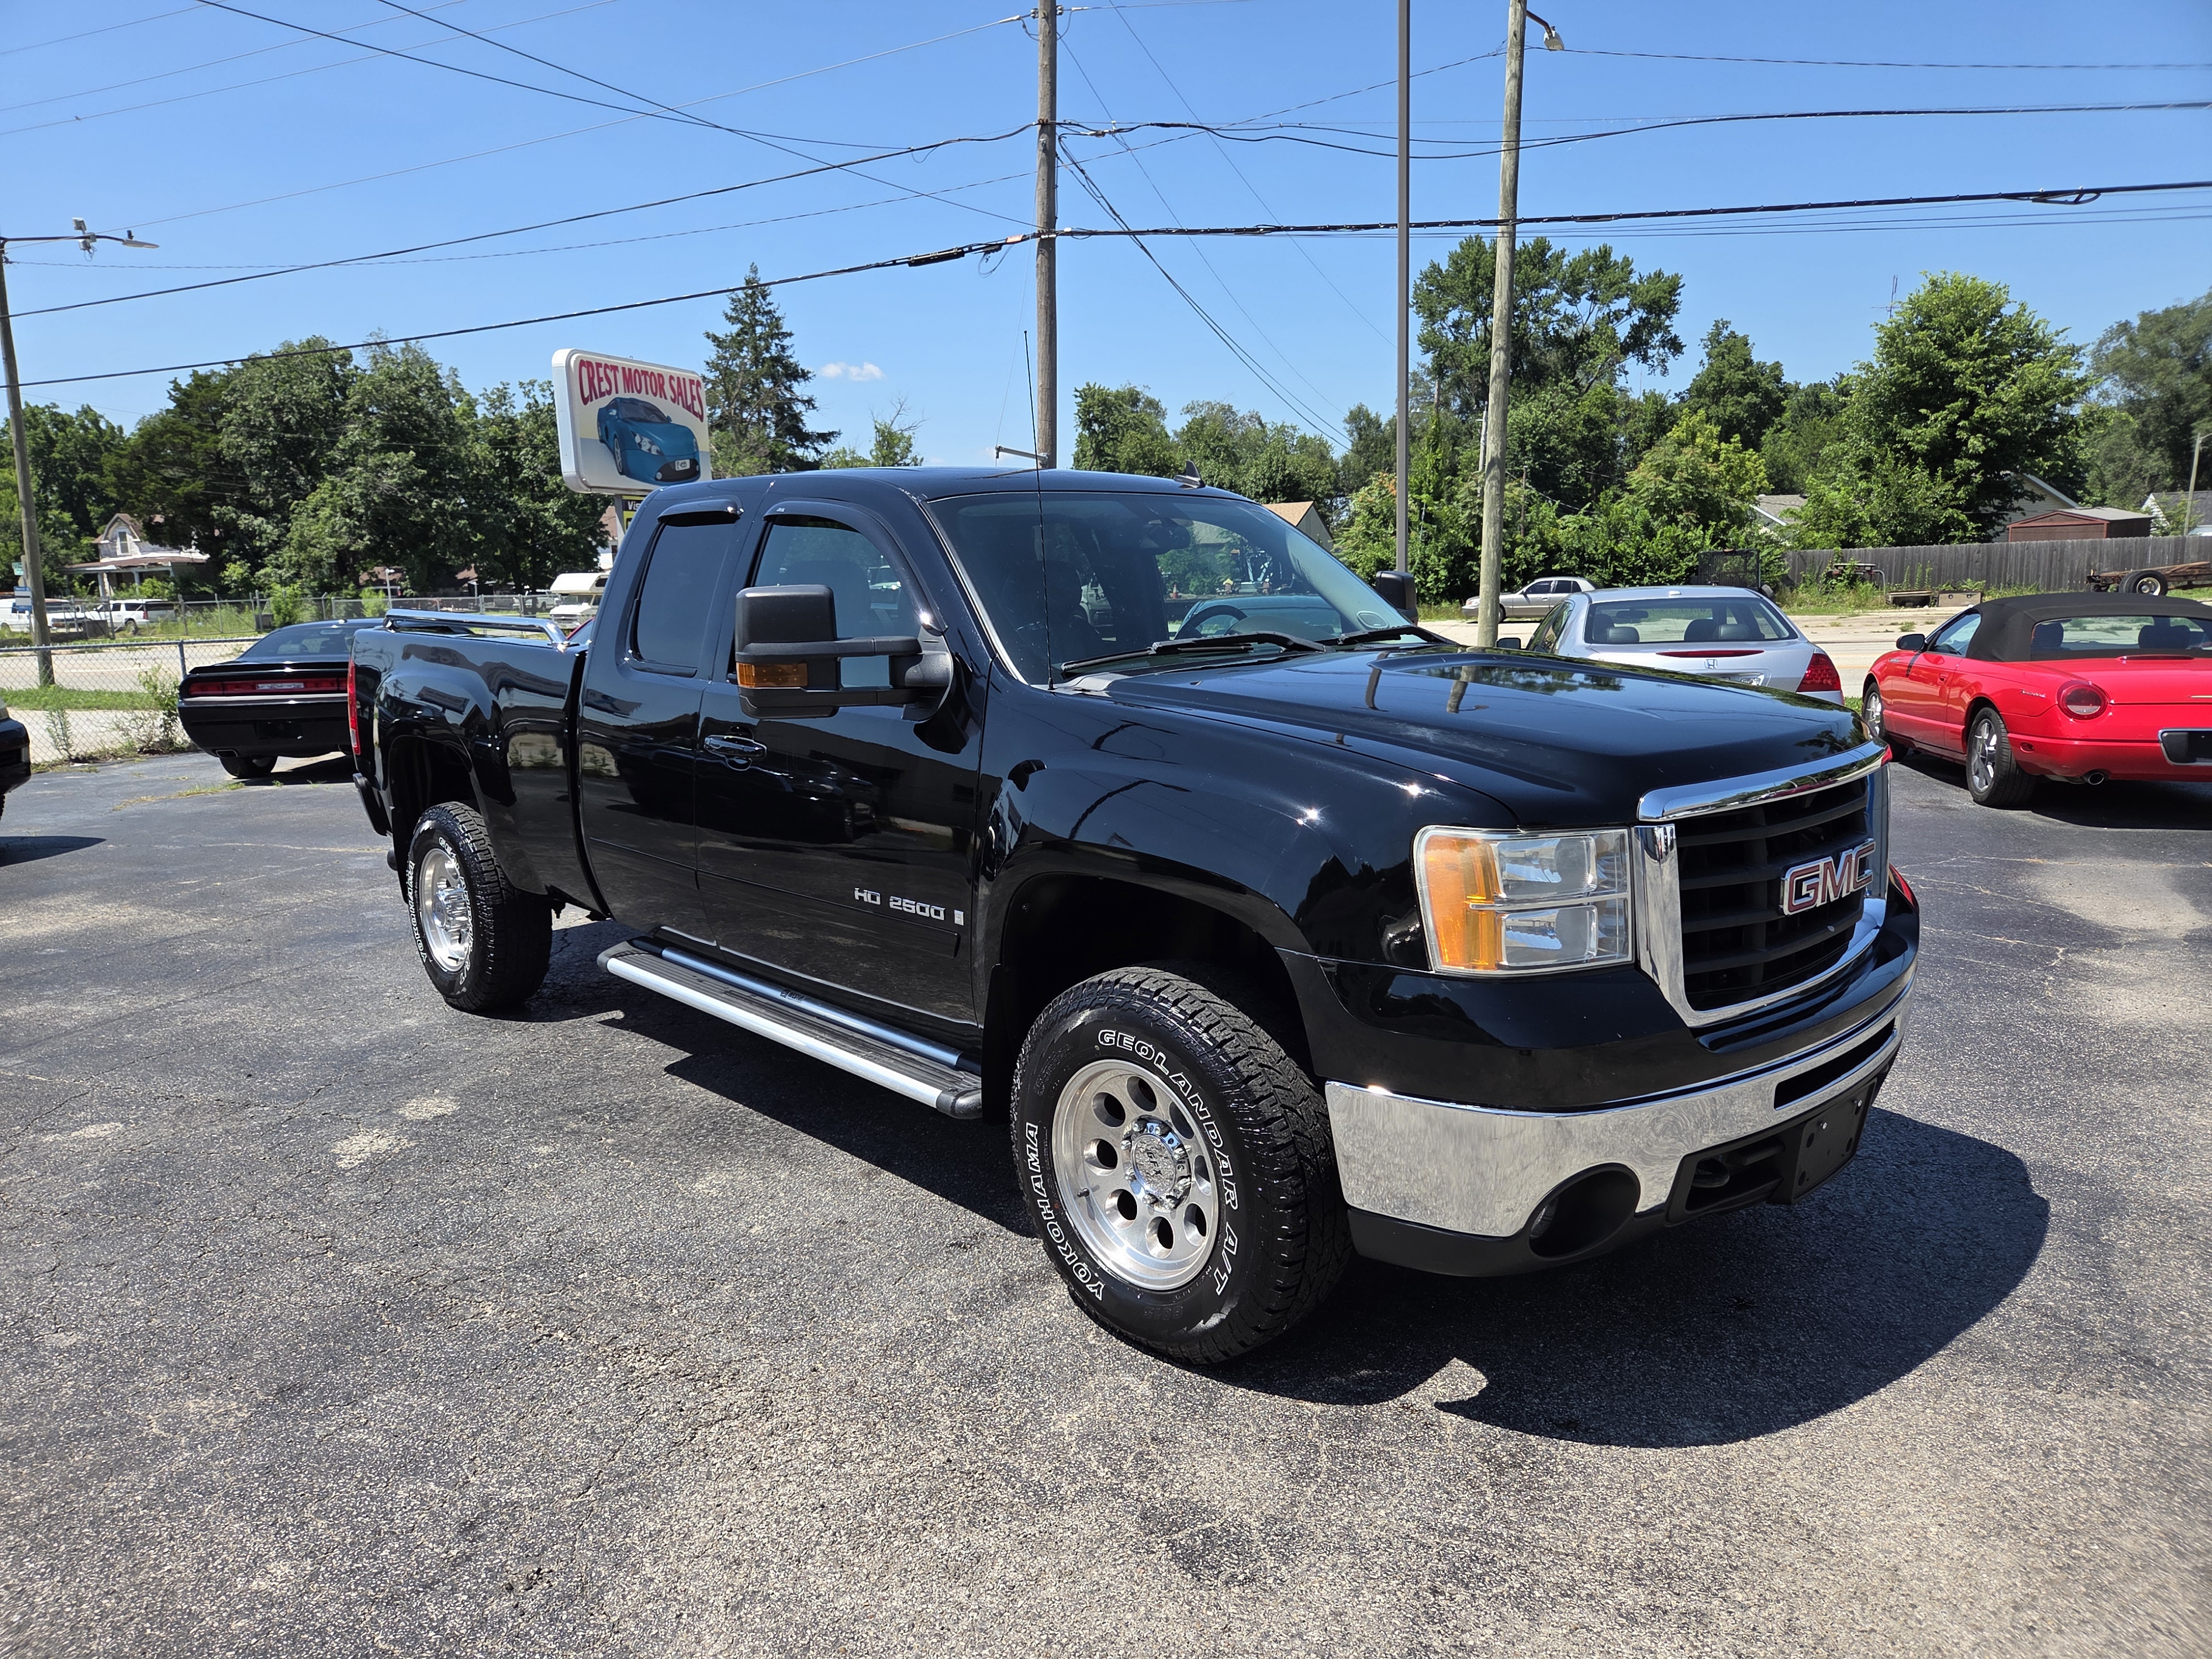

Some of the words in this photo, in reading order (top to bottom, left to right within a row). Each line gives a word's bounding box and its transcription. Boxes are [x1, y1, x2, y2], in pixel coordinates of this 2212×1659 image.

[578, 359, 619, 405] CREST
[622, 367, 667, 400] MOTOR
[669, 375, 704, 422] SALES
[854, 887, 881, 905] HD
[889, 895, 946, 921] 2500
[1780, 838, 1876, 916] GMC
[1098, 1029, 1239, 1210] GEOLANDAR
[1212, 1222, 1239, 1295] A/T
[1024, 1123, 1107, 1301] YOKOHAMA
